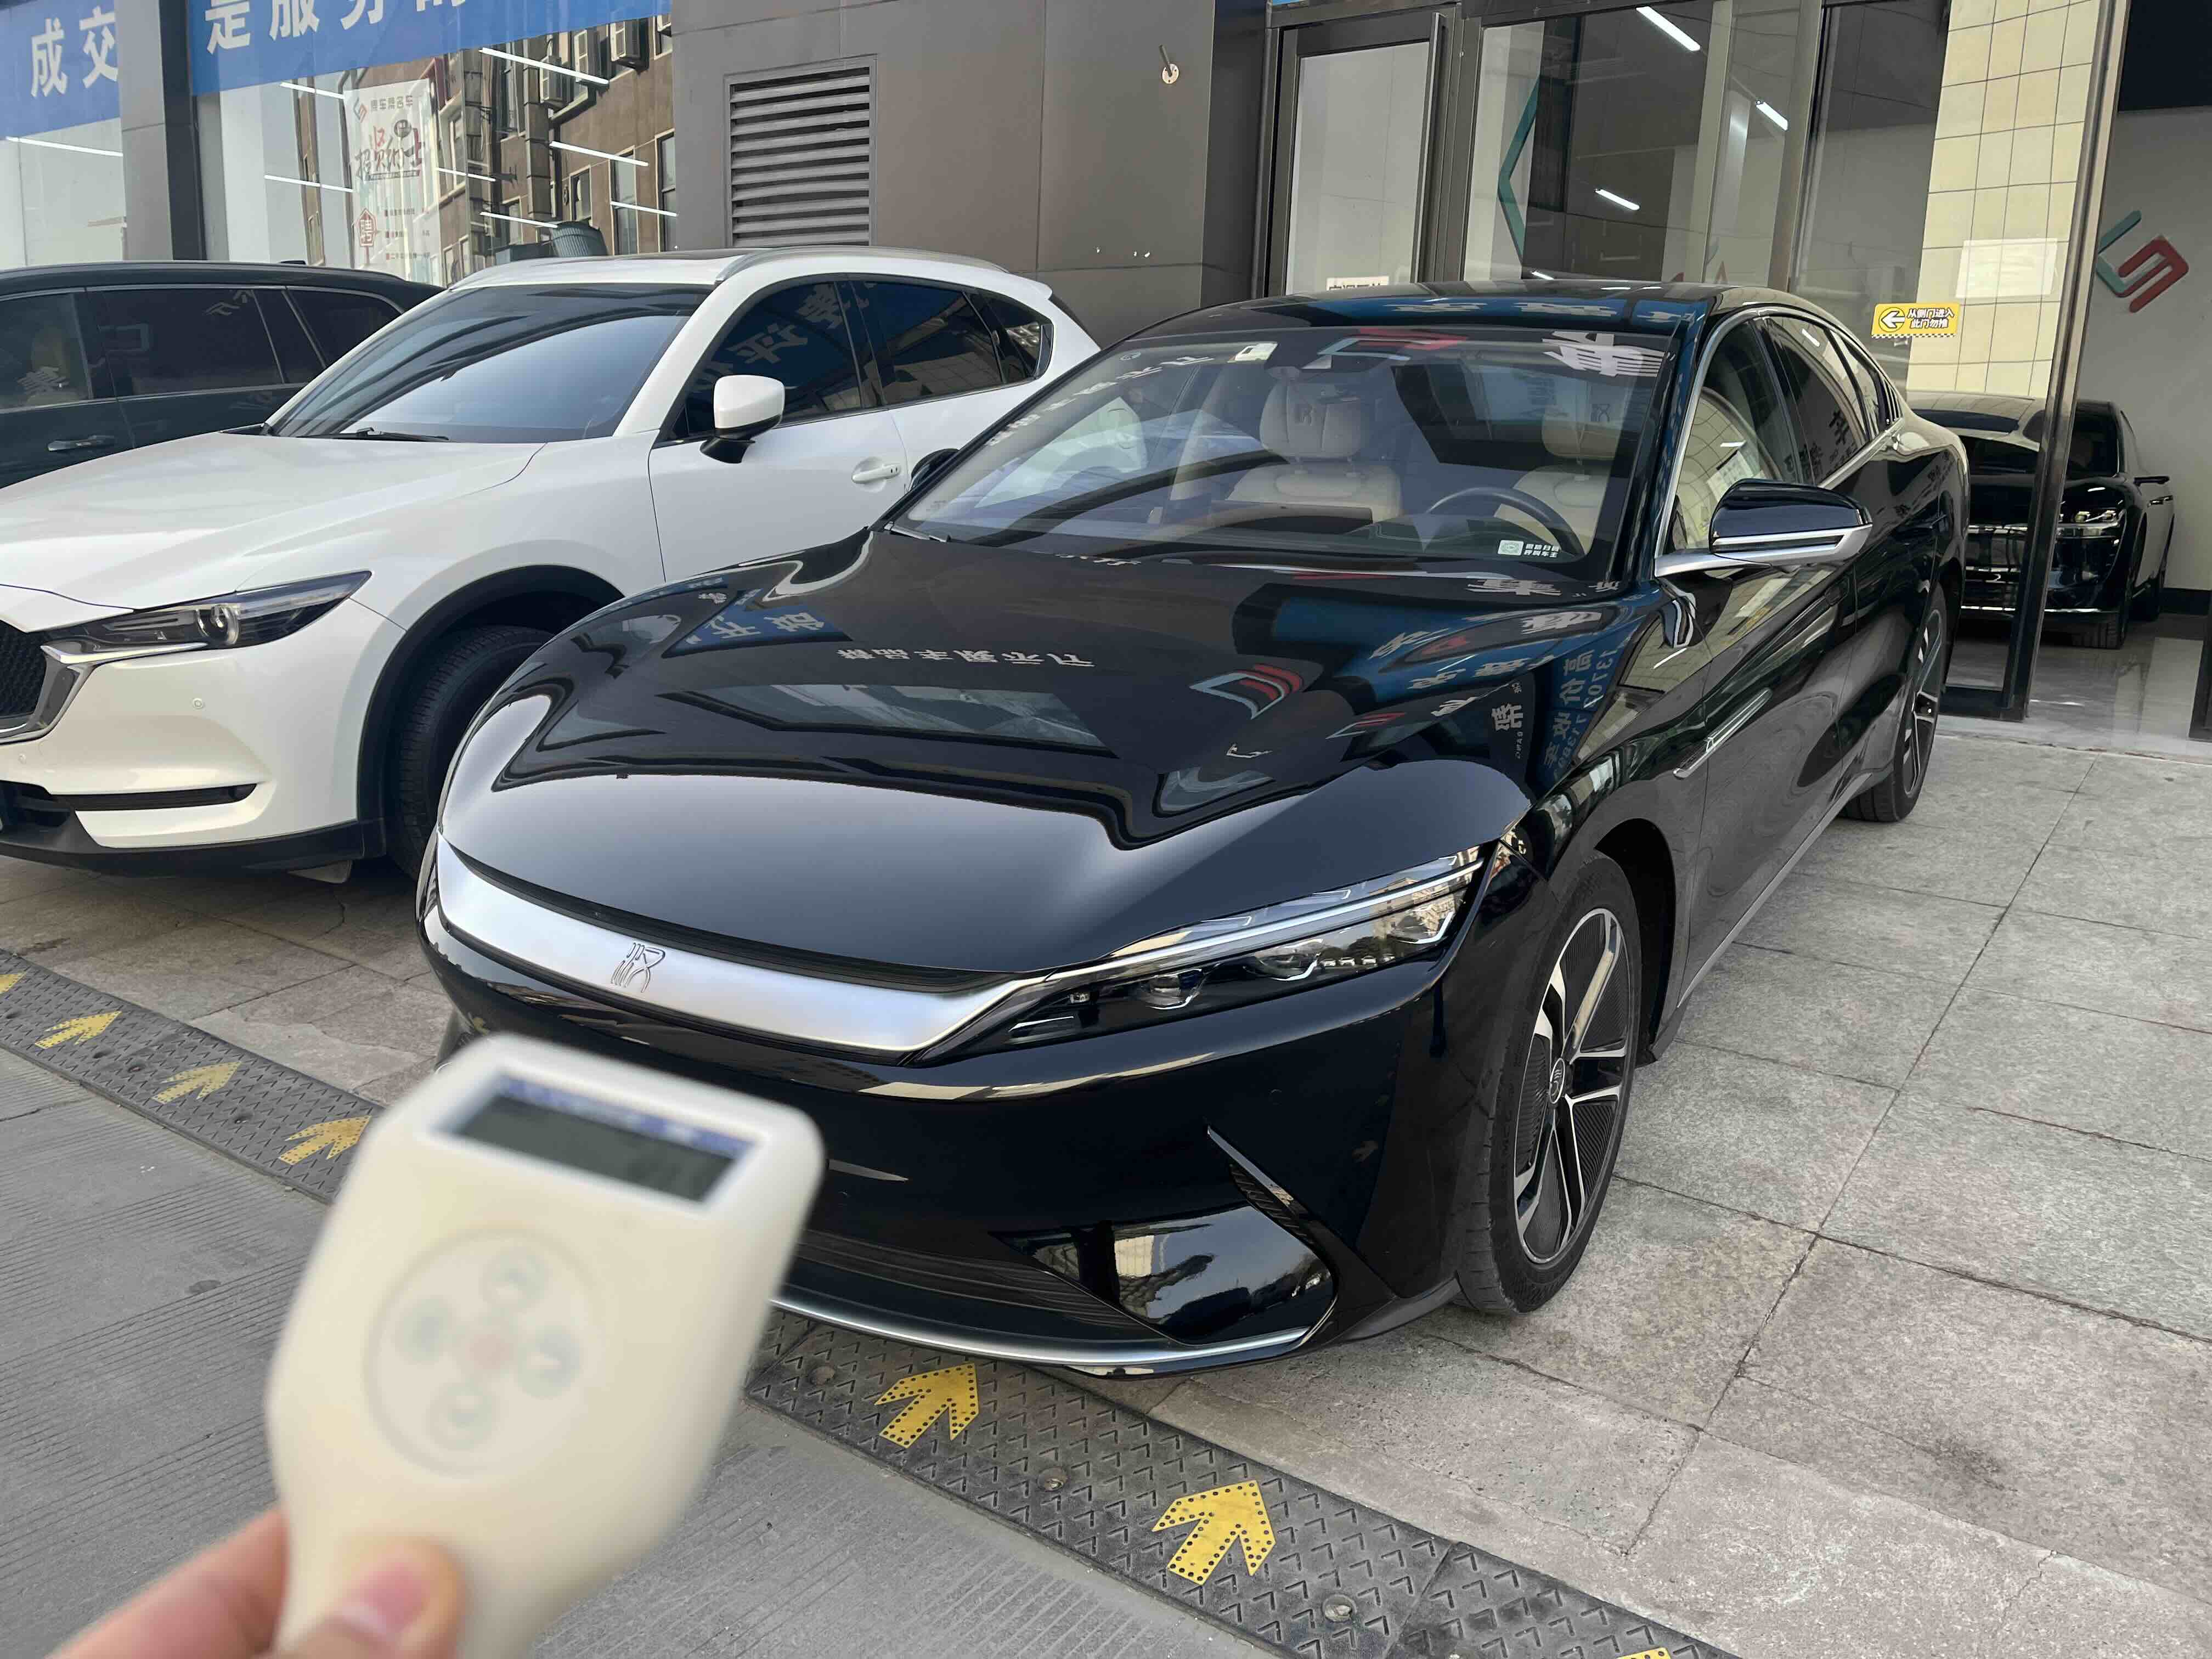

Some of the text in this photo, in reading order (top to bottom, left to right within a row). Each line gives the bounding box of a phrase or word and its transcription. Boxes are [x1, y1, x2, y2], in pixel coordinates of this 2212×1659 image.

[31, 0, 466, 97] 成交 是服
[1907, 307, 1955, 319] 从侧门进入
[1910, 318, 1949, 329] 此门勿推
